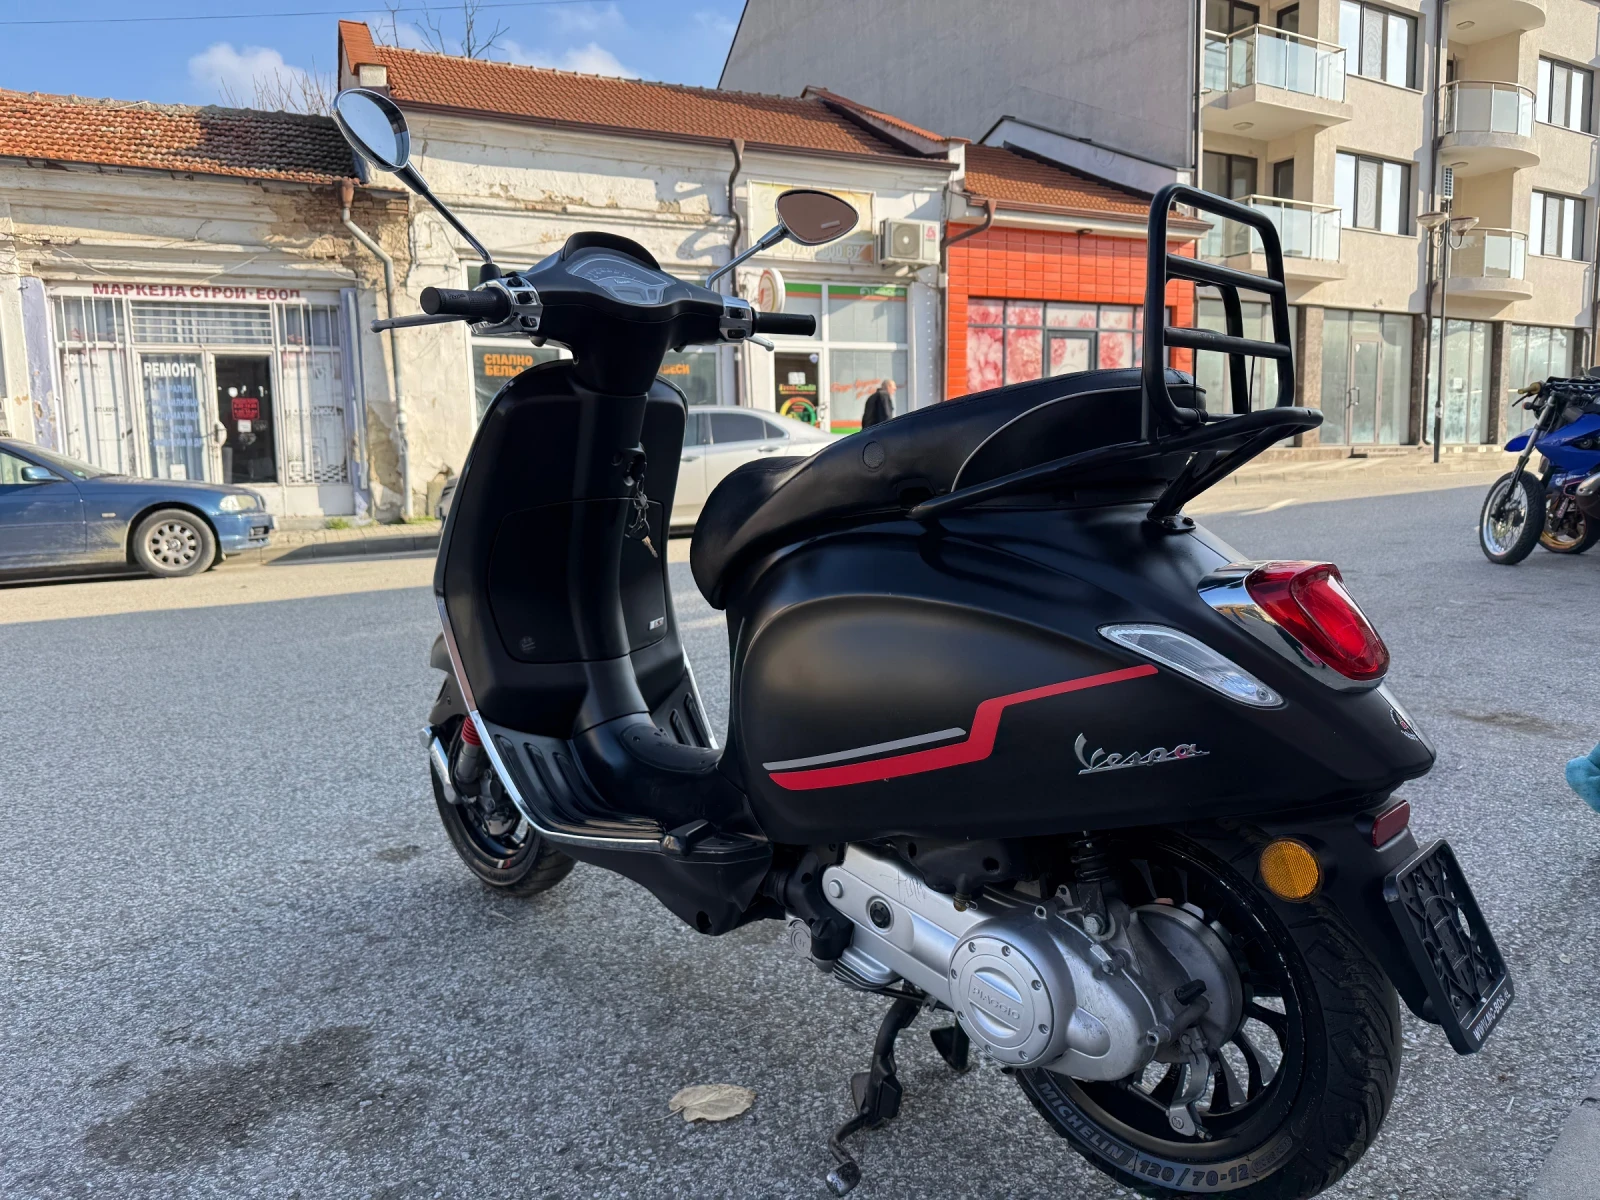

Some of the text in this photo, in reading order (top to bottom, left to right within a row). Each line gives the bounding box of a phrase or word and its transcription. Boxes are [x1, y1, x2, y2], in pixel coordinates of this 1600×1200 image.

[92, 283, 187, 298] МАРКЕЛА
[143, 362, 197, 377] РЕМОНТ
[484, 353, 533, 366] СПАЛНО
[1074, 732, 1210, 775] Vespa
[972, 986, 1021, 1021] PIAGGIO
[1039, 1082, 1125, 1160] MICHELIN
